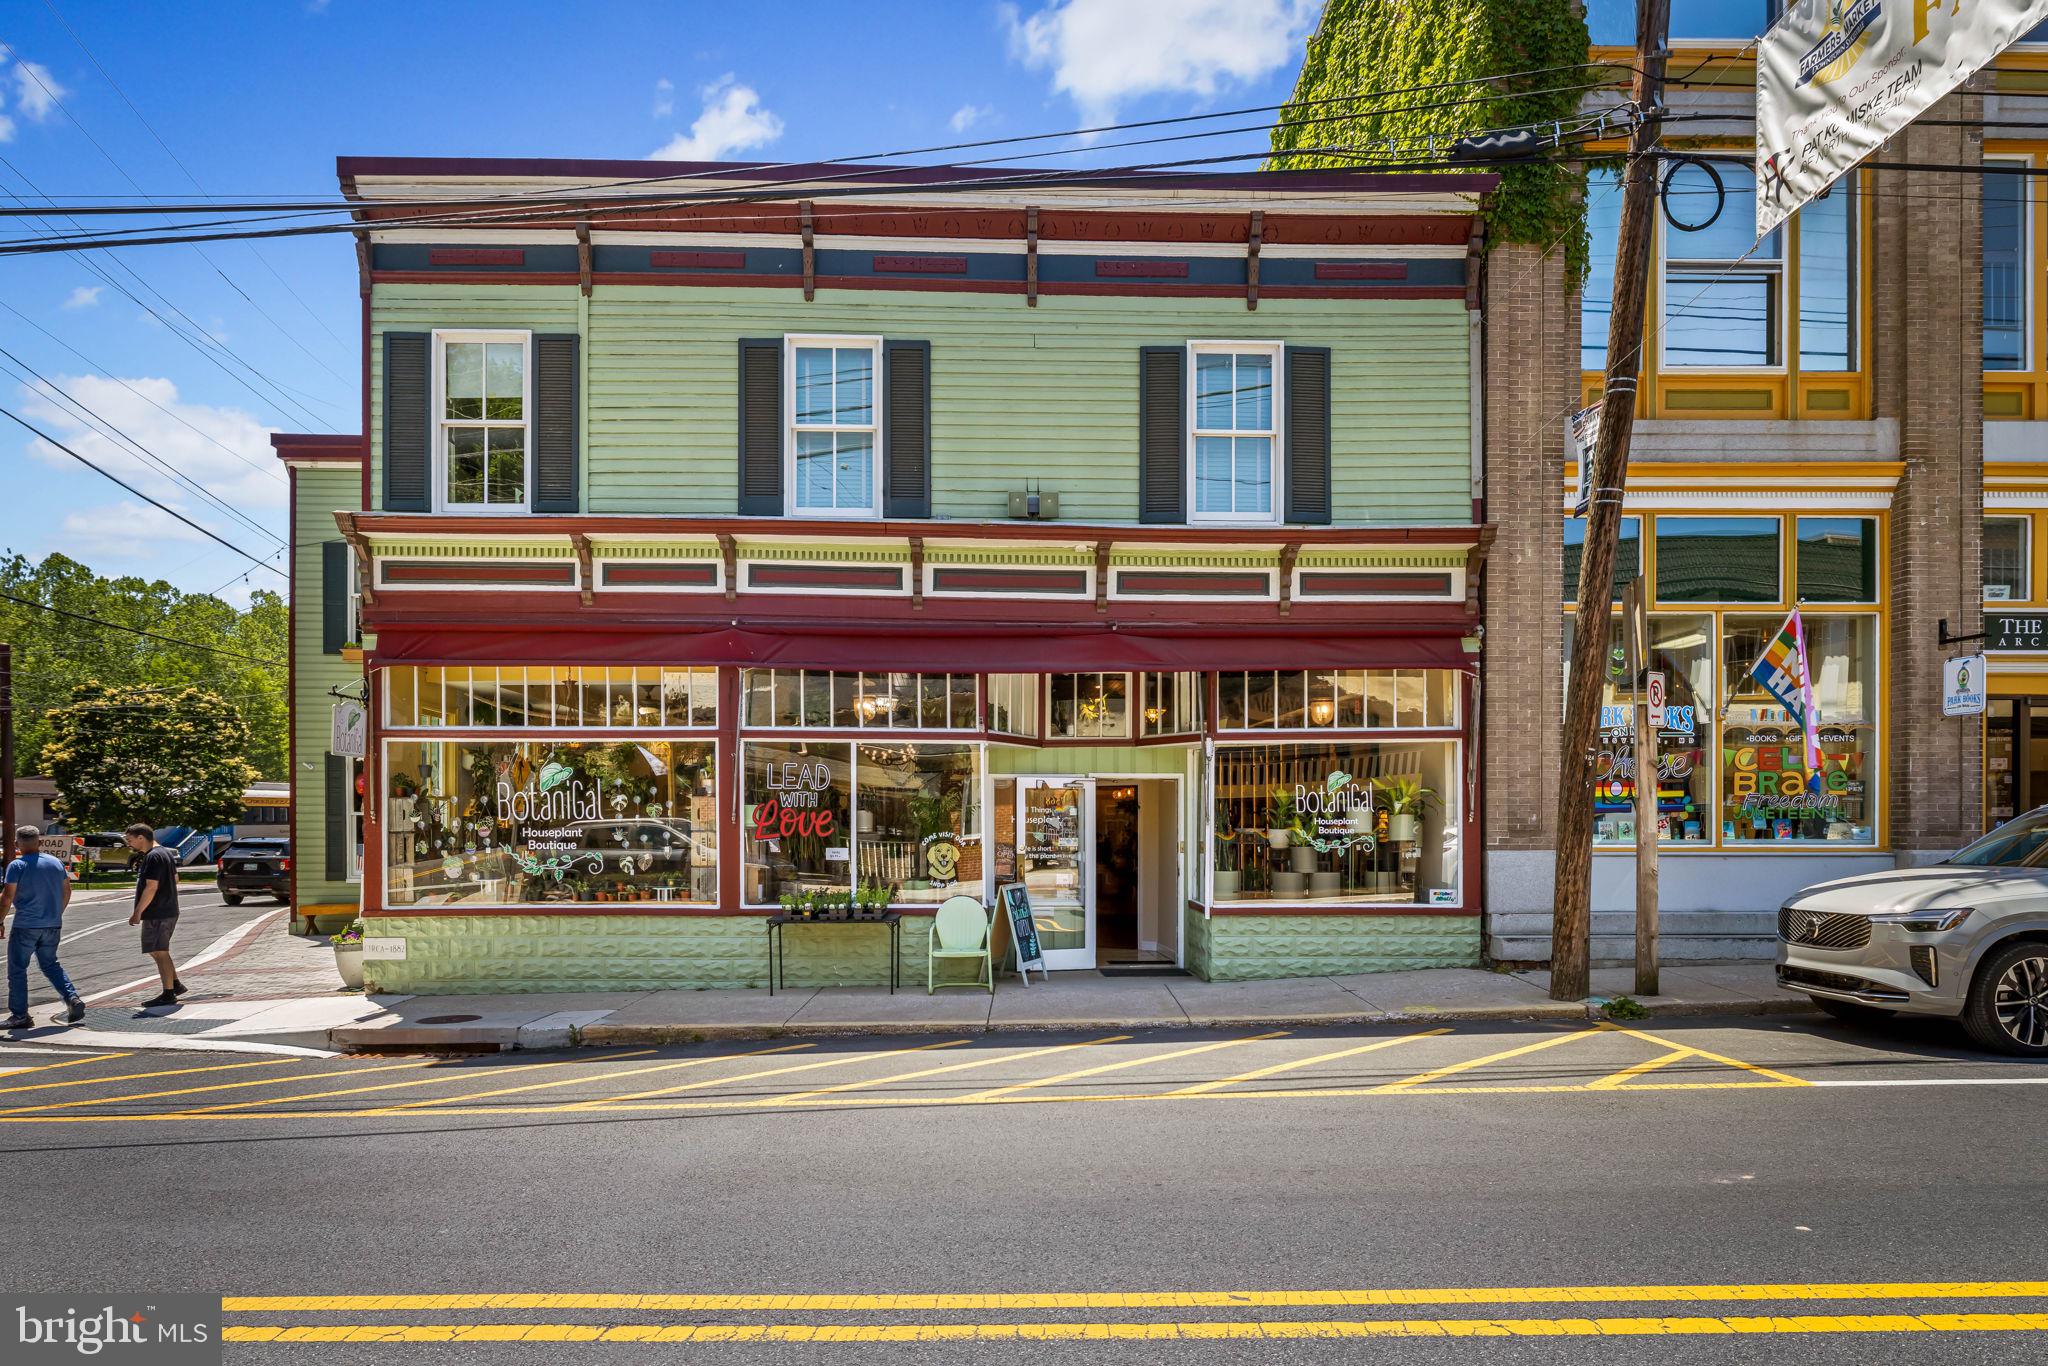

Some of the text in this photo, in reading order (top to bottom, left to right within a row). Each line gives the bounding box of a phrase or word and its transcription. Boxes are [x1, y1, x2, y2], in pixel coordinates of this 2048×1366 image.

[1800, 32, 1842, 75] FARMERS
[1849, 79, 1869, 98] Our
[1802, 129, 1823, 158] PAT
[1887, 58, 1922, 99] TEAM
[1999, 618, 2043, 634] THE
[1998, 637, 2048, 647] ARC
[1823, 734, 1855, 742] EVENTS
[767, 762, 831, 791] LEAD
[497, 778, 604, 821] BotaniGal
[779, 791, 818, 807] WITH
[1295, 782, 1375, 813] BotaniGal
[1742, 789, 1839, 811] Freedom
[752, 799, 834, 840] Love
[1733, 806, 1847, 820] JUNETEENTH
[1314, 817, 1359, 826] Houseplant
[522, 827, 583, 839] Houseplant
[921, 832, 937, 846] COME
[1318, 827, 1354, 835] Boutique
[39, 839, 64, 848] ROAD
[528, 840, 577, 851] Boutique
